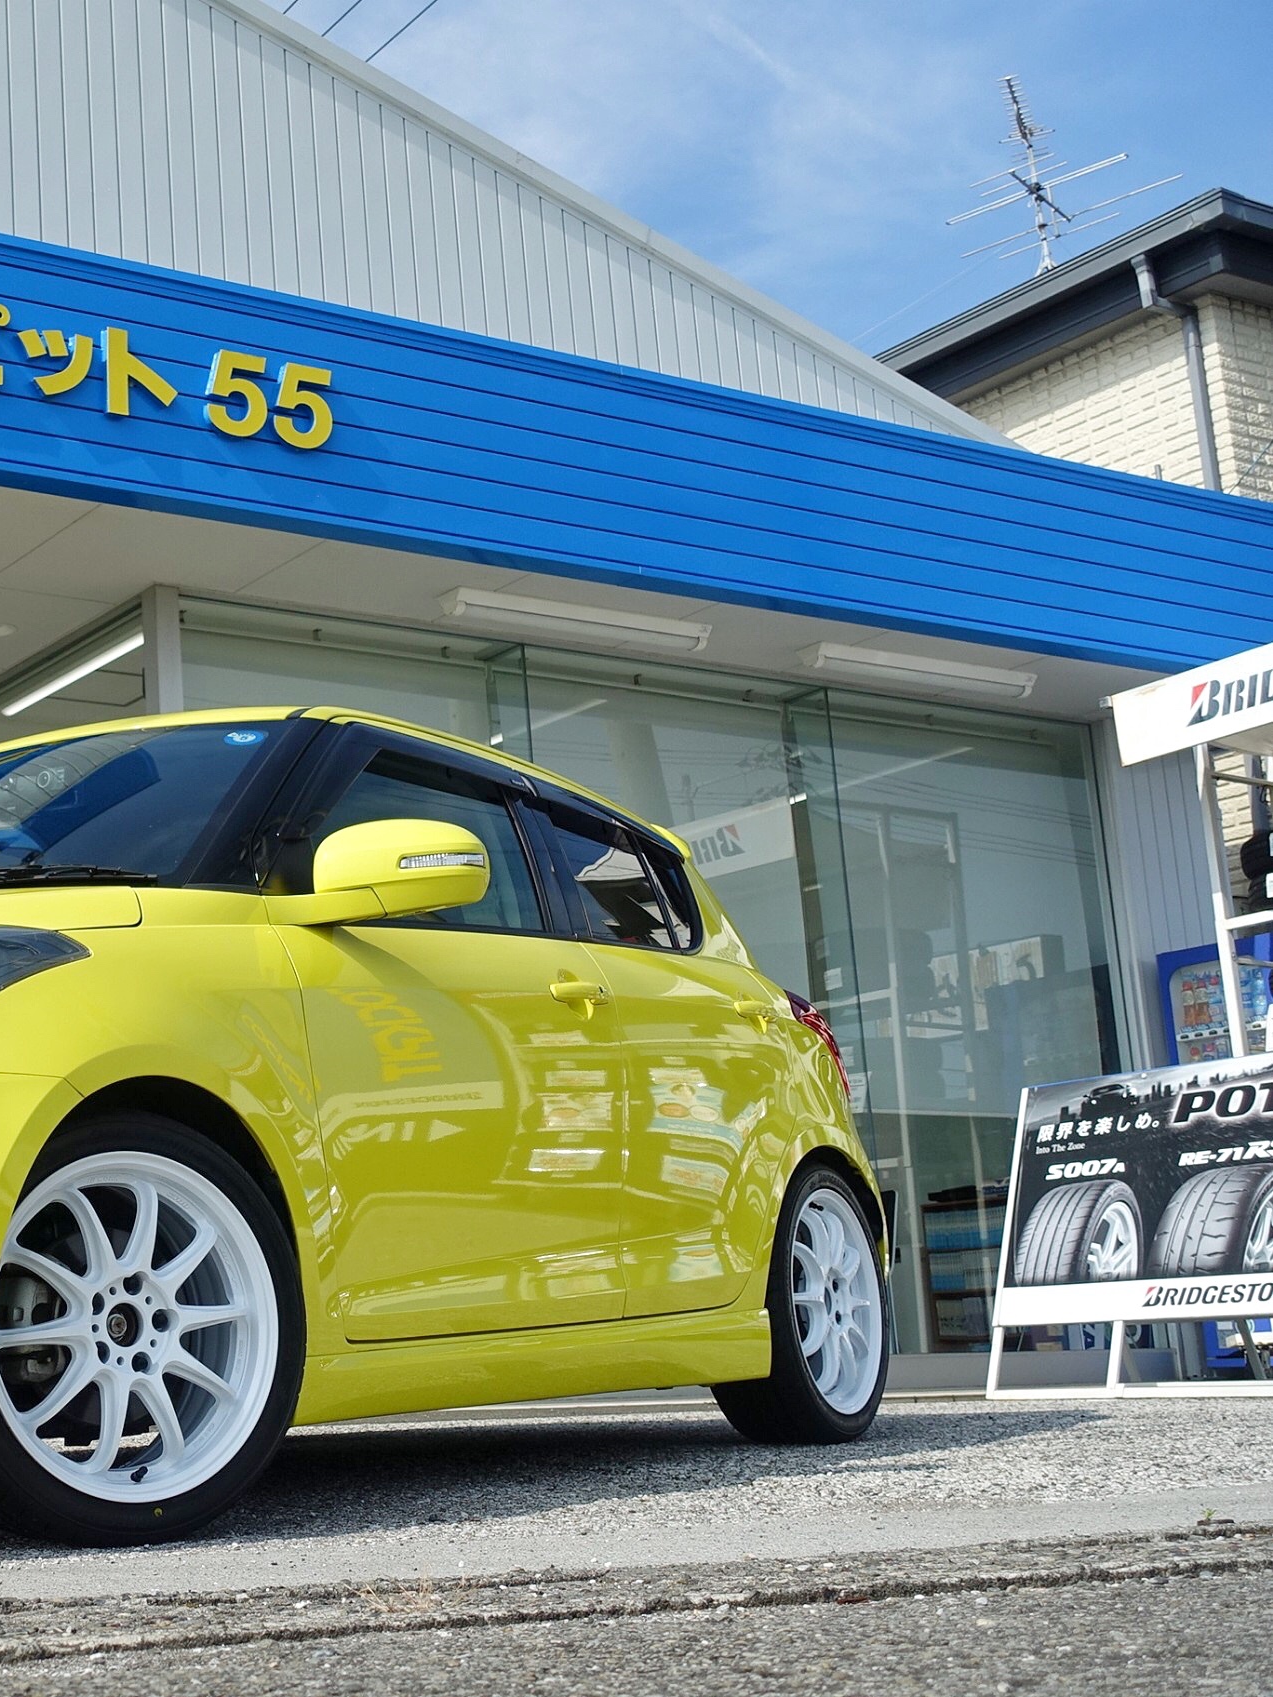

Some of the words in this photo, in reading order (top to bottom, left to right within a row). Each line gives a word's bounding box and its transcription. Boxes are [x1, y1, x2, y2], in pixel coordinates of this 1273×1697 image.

[204, 348, 333, 450] 55
[1036, 1112, 1160, 1143] 限界を楽しめ。
[1035, 1146, 1050, 1155] Into
[1051, 1144, 1066, 1153] The
[1067, 1142, 1086, 1151] Zone
[1045, 1158, 1126, 1181] S007A
[1142, 1282, 1273, 1308] BRIDGESTO
